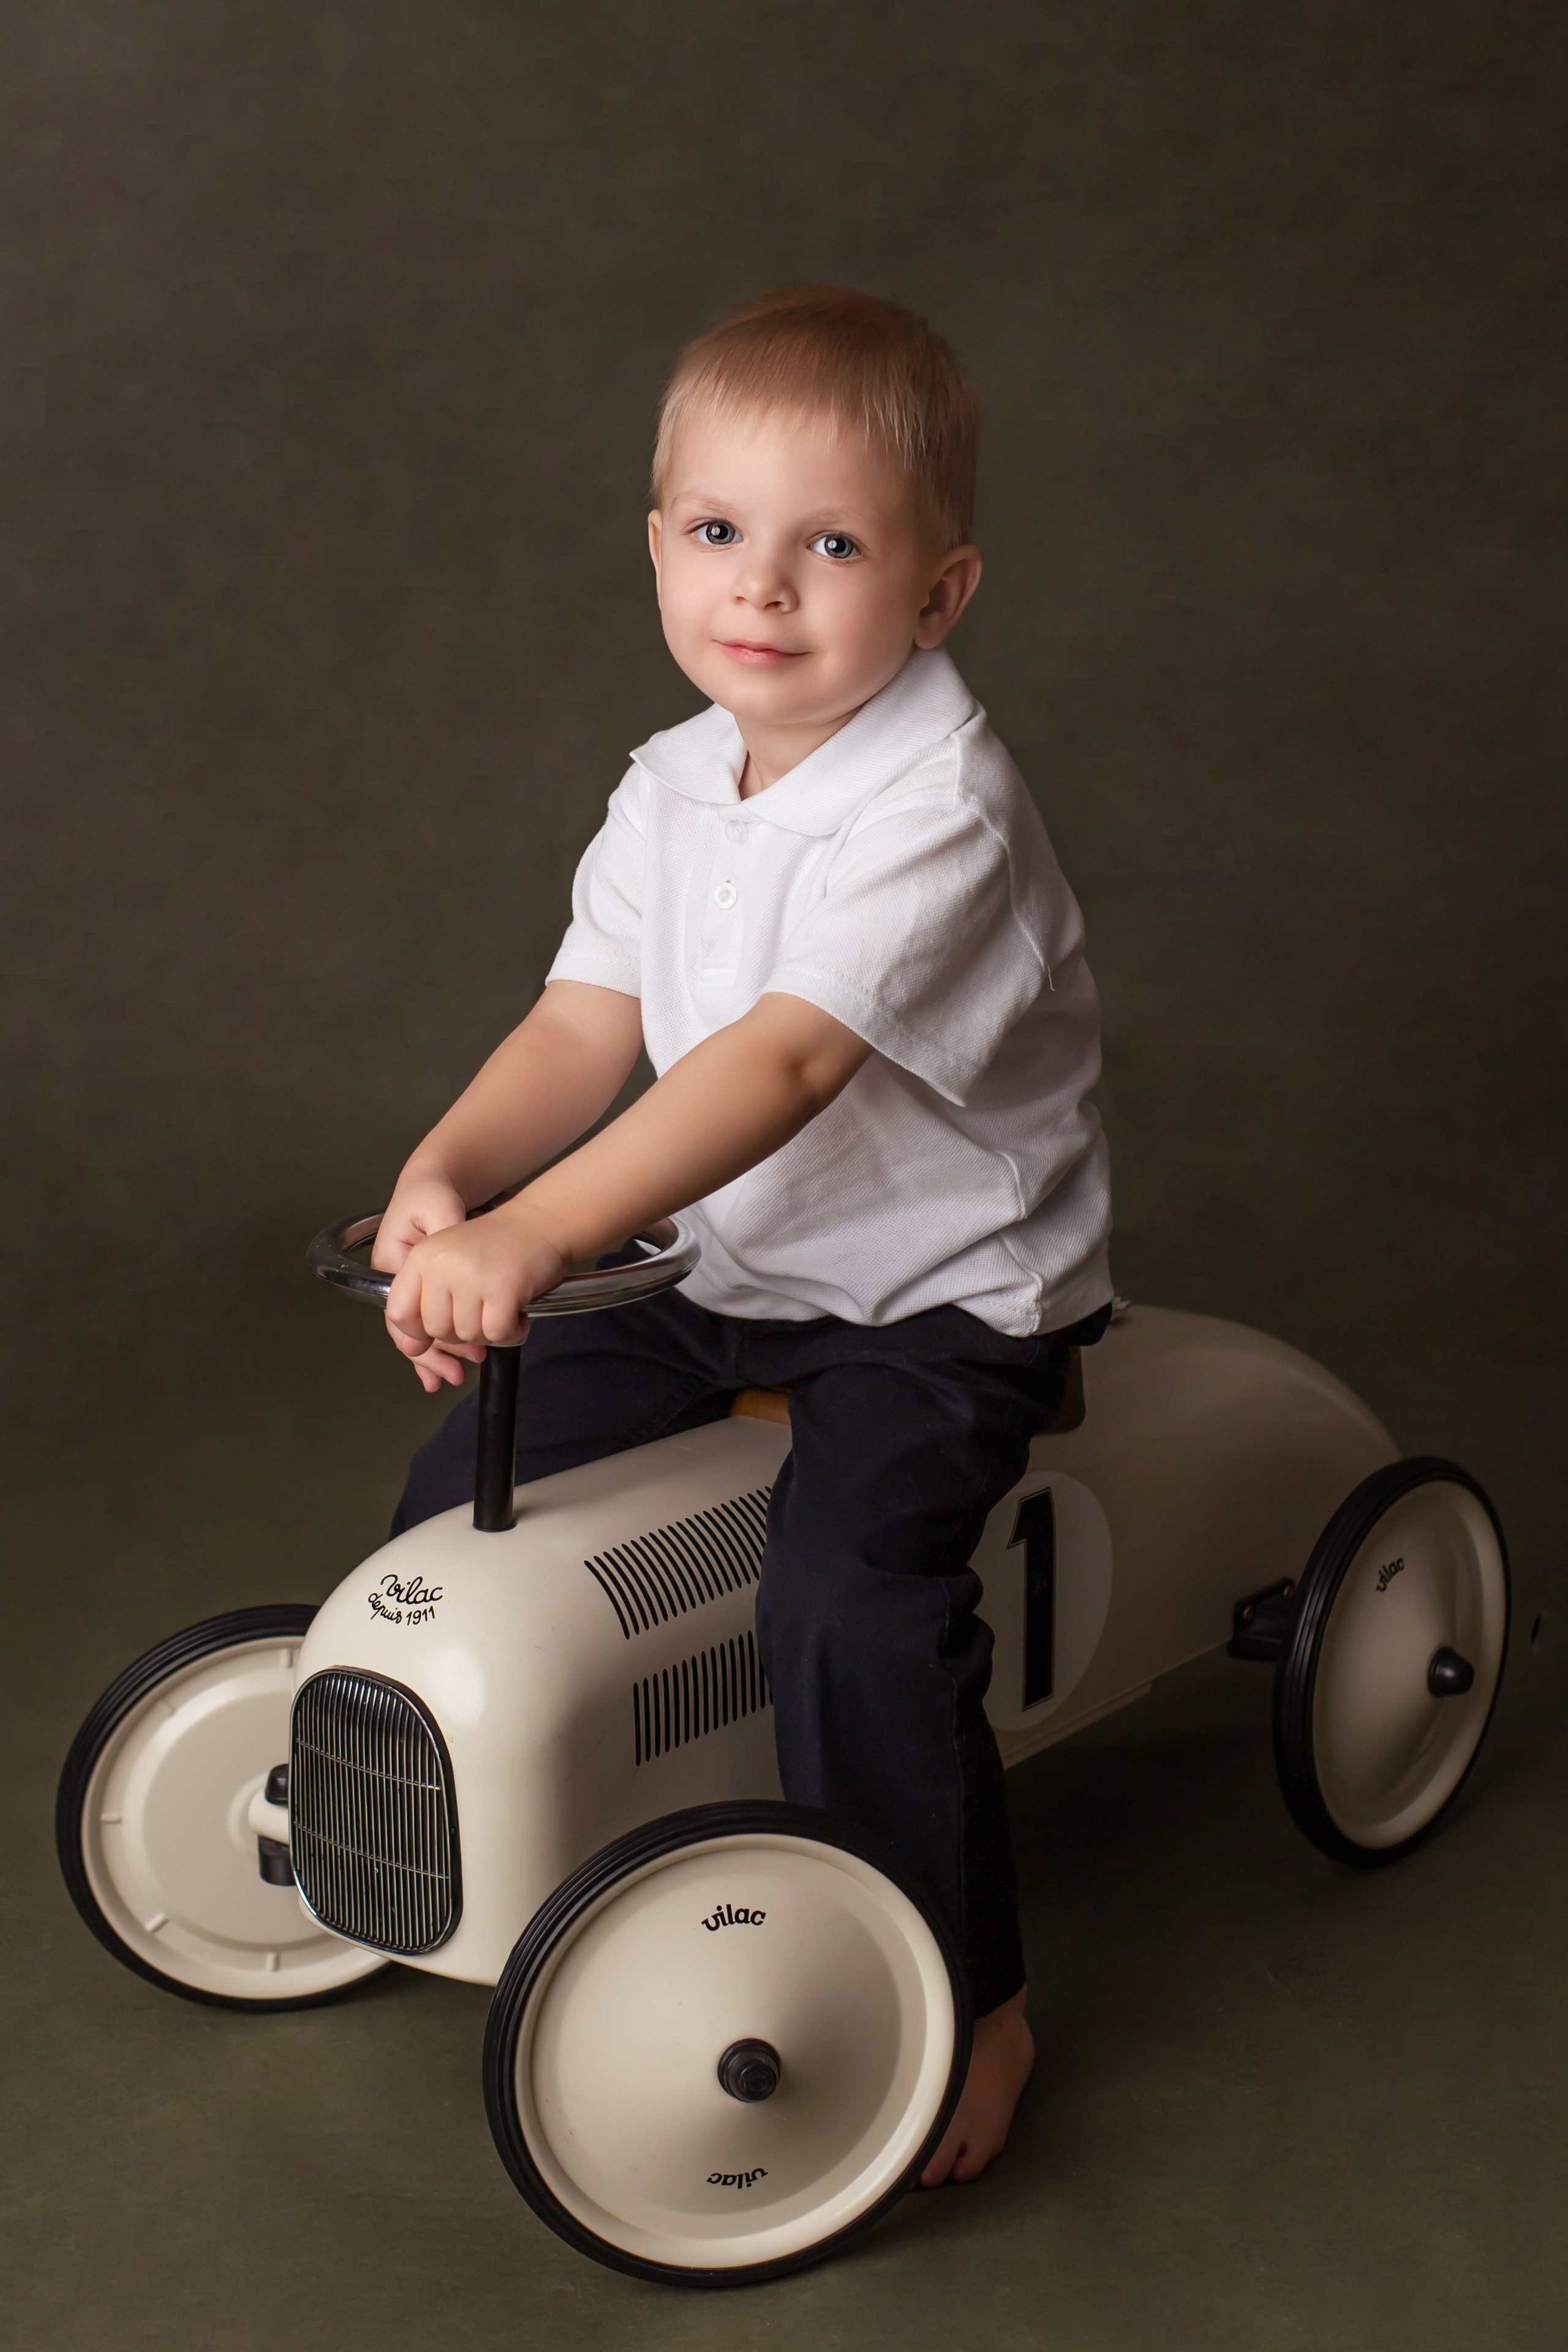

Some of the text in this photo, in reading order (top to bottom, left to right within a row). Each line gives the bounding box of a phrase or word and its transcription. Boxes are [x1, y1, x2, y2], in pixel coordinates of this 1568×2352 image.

[380, 1574, 443, 1605] Vilac
[1376, 1558, 1404, 1593] vilac
[368, 1593, 435, 1626] depuis 1911
[1006, 1487, 1056, 1712] 1
[701, 1904, 766, 1931] vilac
[706, 2168, 768, 2189] vilac
